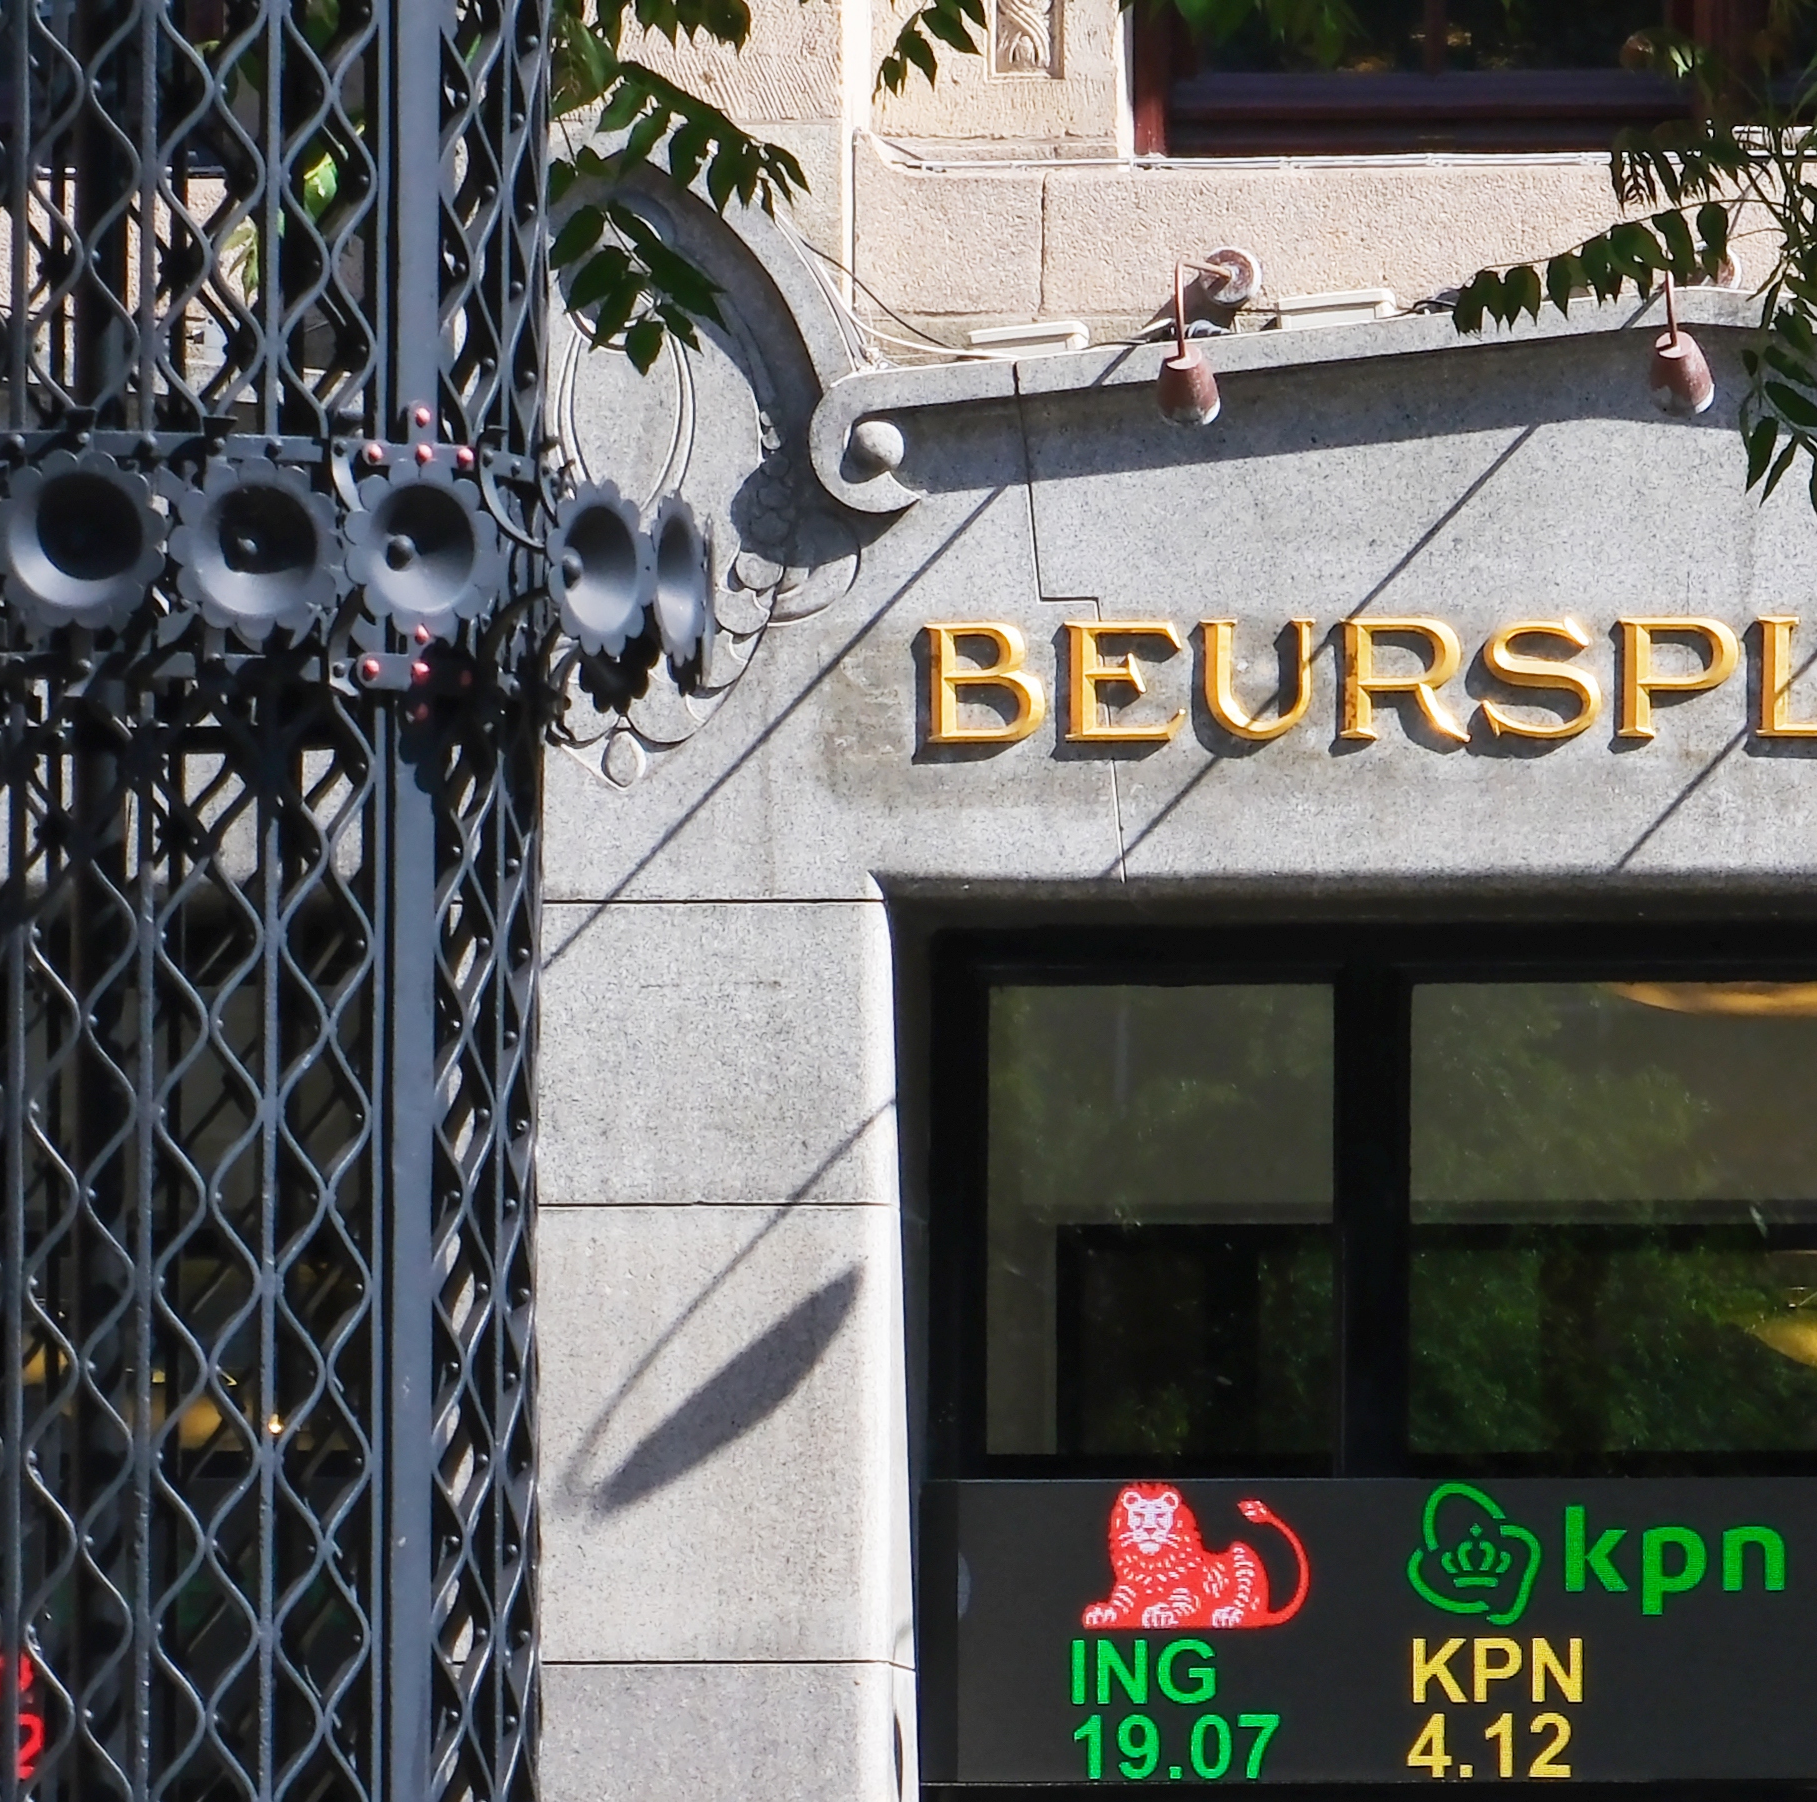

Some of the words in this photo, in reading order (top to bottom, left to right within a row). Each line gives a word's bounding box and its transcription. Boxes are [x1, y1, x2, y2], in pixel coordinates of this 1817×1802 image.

[1564, 1505, 1788, 1616] kpn
[1071, 1638, 1218, 1706] ING
[1411, 1637, 1584, 1705] KPN
[1072, 1713, 1281, 1780] 19.07
[1406, 1712, 1573, 1779] 4.12
